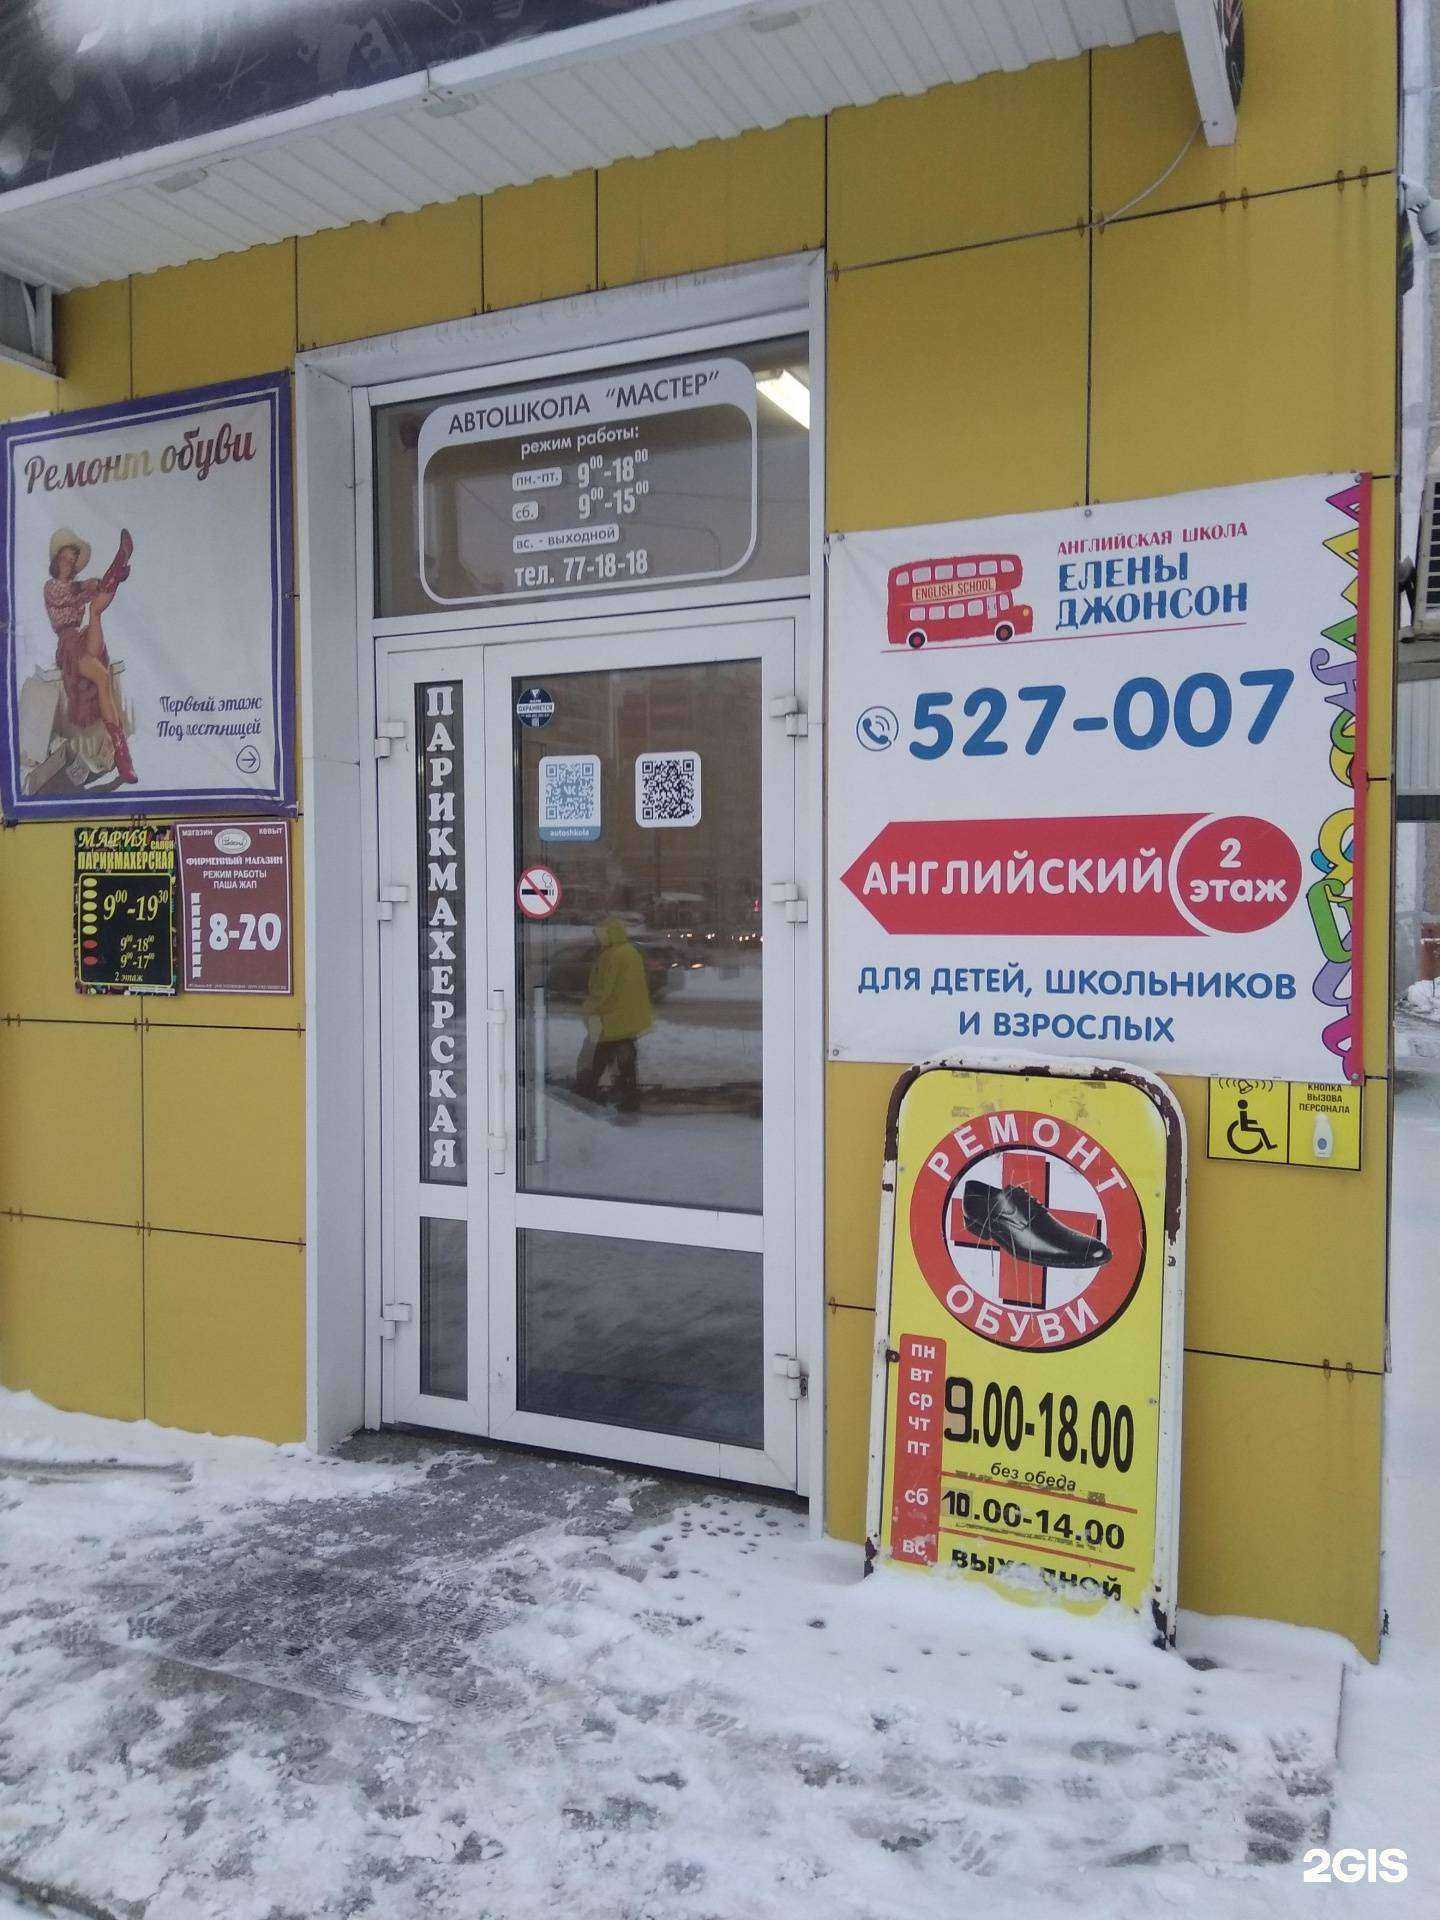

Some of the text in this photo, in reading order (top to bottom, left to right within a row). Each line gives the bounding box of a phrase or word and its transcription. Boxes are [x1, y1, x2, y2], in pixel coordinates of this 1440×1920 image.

[448, 392, 591, 435] АВТОШКОЛА
[24, 422, 256, 493] Ремонт обуви
[520, 426, 640, 460] режим работы:
[515, 504, 534, 519] сб.
[1058, 521, 1248, 556] АНГЛИЙСКАЯ ШКОЛА
[514, 549, 648, 587] тел. 77-18-18
[1058, 552, 1189, 592] ЕЛЕНЫ
[915, 577, 994, 600] ENGLISH SCHOOL
[1056, 582, 1247, 631] ДЖОНСОН
[160, 696, 262, 716] Первый этаж
[909, 668, 1295, 760] 527-007
[157, 718, 261, 741] Под лестницей
[78, 851, 174, 870] ПАРИКМАХЕРСКАЯ
[245, 856, 283, 865] МАГАЗИН
[1219, 838, 1242, 868] 2
[203, 870, 267, 878] РЕЖИМ РАБОТЫ
[862, 847, 1163, 895] АНГЛИЙСКИЙ
[1189, 876, 1288, 902] этаж
[209, 913, 282, 951] 8-20
[426, 686, 458, 1169] ПАРИКМАХЕРСКАЯ
[114, 971, 120, 982] 2
[858, 962, 1297, 1000] ДЛЯ ДЕТЕЙ, ШКОЛЬНИКОВ
[959, 1010, 1175, 1042] И ВЗРОСЛЫХ
[1307, 1093, 1343, 1103] ВЫЗОВА
[1308, 1083, 1342, 1092] КНОПКА
[1299, 1103, 1350, 1114] ПЕРСОНАЛА
[927, 1113, 1128, 1193] РЕМОНТ
[946, 1283, 1099, 1344] ОБУВИ
[909, 1391, 932, 1411] ср
[944, 1376, 1134, 1473] 9.00-18.00
[990, 1462, 1077, 1492] без обеда
[904, 1488, 929, 1506] сб
[941, 1490, 1125, 1550] 10.00-14.00
